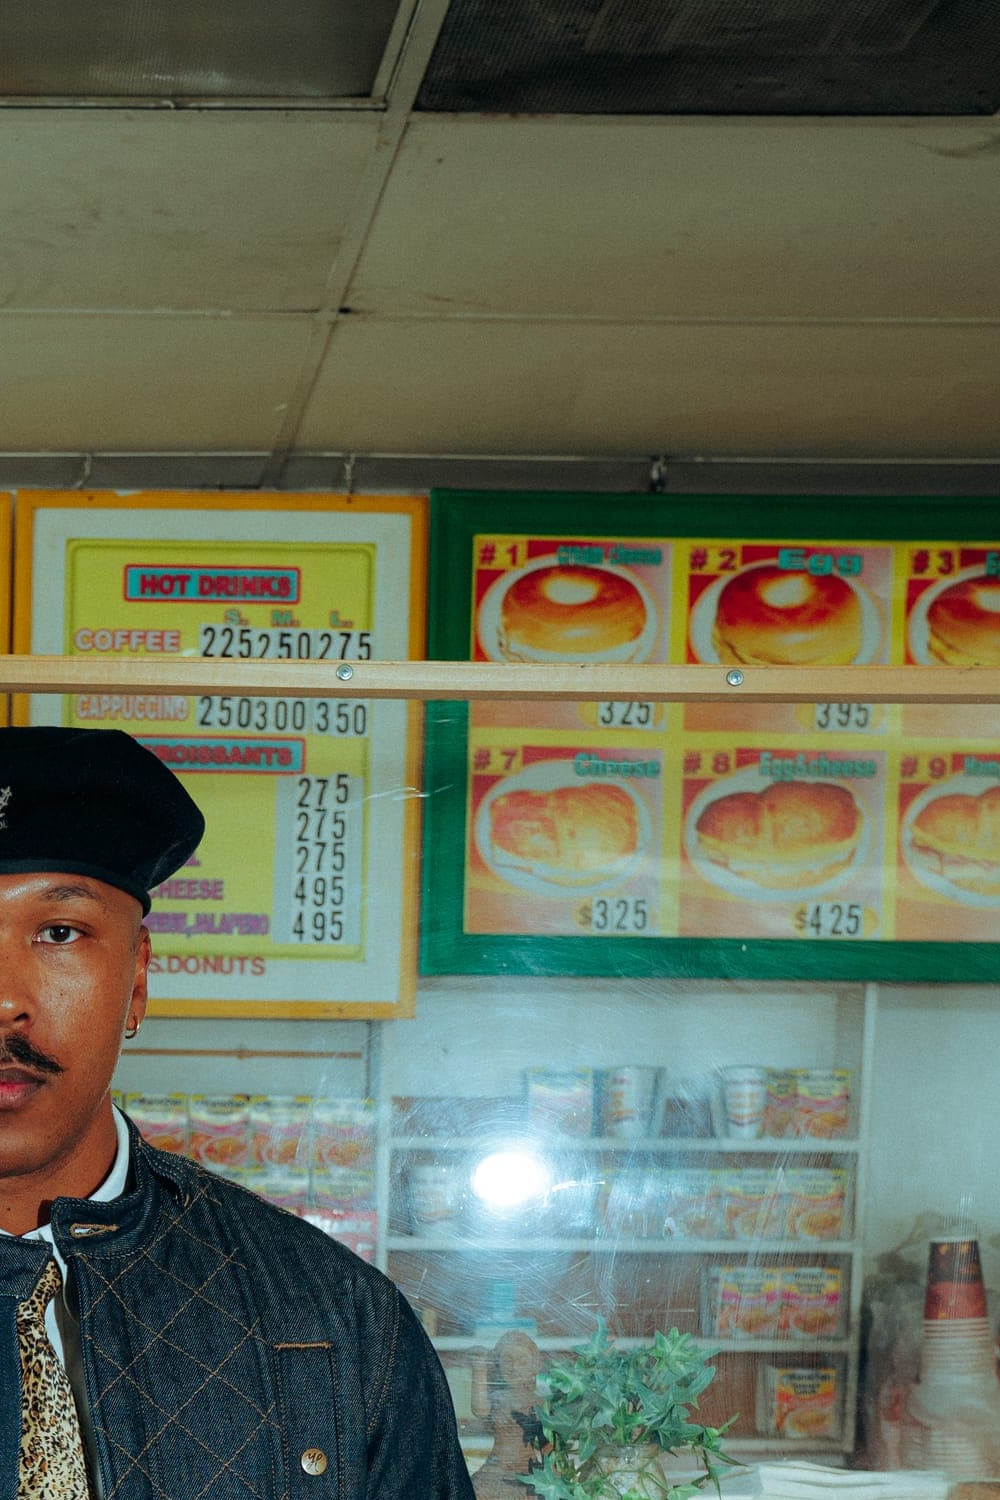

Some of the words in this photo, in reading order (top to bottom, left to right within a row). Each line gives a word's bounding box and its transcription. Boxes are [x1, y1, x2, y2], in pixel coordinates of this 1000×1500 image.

[777, 548, 863, 577] Egg
[140, 574, 190, 596] HOT
[198, 575, 291, 597] DRINKS
[75, 628, 181, 653] COFFEE
[76, 694, 190, 721] CAPPUCCINO
[144, 744, 292, 766] ROISSANTS
[574, 752, 660, 778] Cheese
[298, 774, 349, 808] 275
[297, 809, 346, 842] 275
[297, 842, 345, 873] 275
[295, 876, 344, 907] 495
[293, 911, 344, 942] 495
